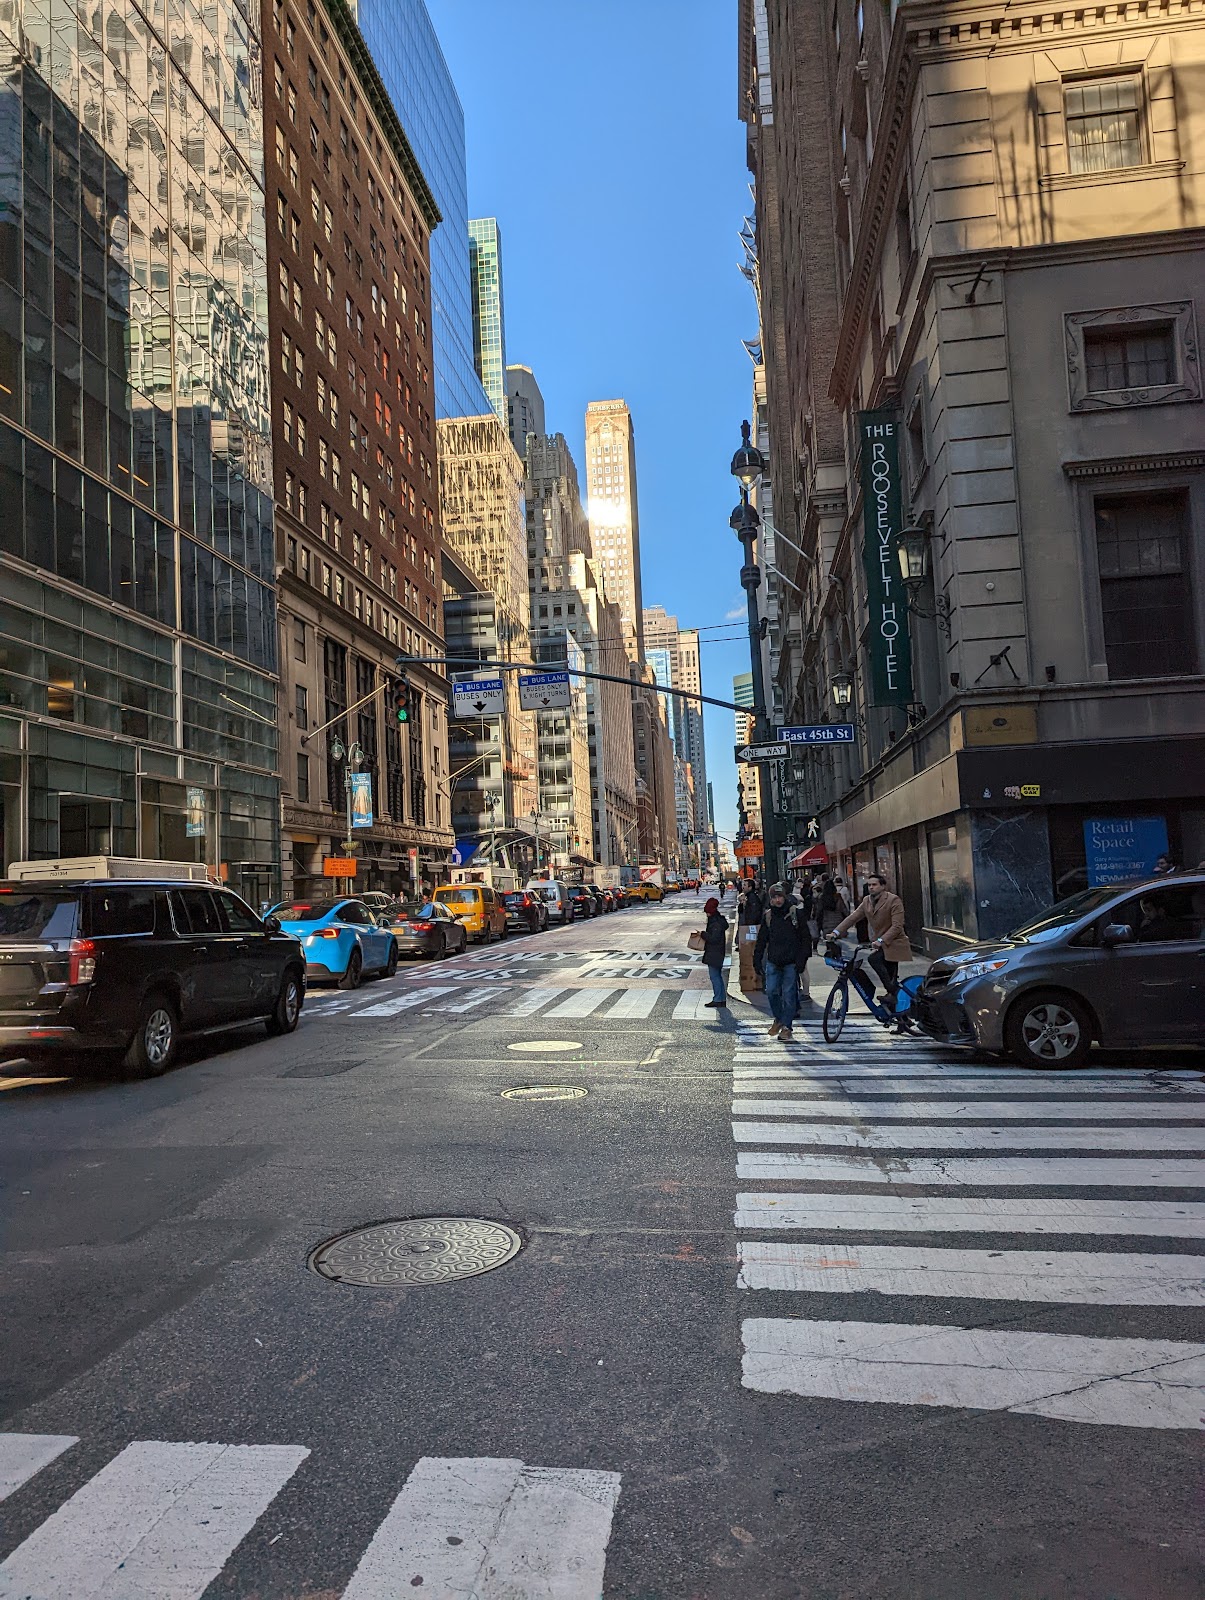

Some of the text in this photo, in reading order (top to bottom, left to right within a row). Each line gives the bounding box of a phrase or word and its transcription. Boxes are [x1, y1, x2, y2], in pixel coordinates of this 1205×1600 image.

[865, 423, 893, 438] THE
[871, 443, 892, 597] ROOSEVELT
[880, 602, 899, 690] HOTEL
[531, 674, 567, 684] BUS LANE
[466, 683, 480, 691] BUS
[526, 685, 545, 693] BUSES
[456, 690, 501, 701] BUSES ONLY
[529, 691, 546, 699] RIGHT
[782, 728, 849, 741] East 45th St
[743, 746, 783, 757] ONE WAY
[1092, 820, 1134, 834] Retail
[1092, 836, 1135, 853] Space
[467, 952, 576, 962] ONLY
[602, 952, 702, 962] ONLY
[404, 968, 528, 980] BUS
[585, 967, 687, 979] BUS
